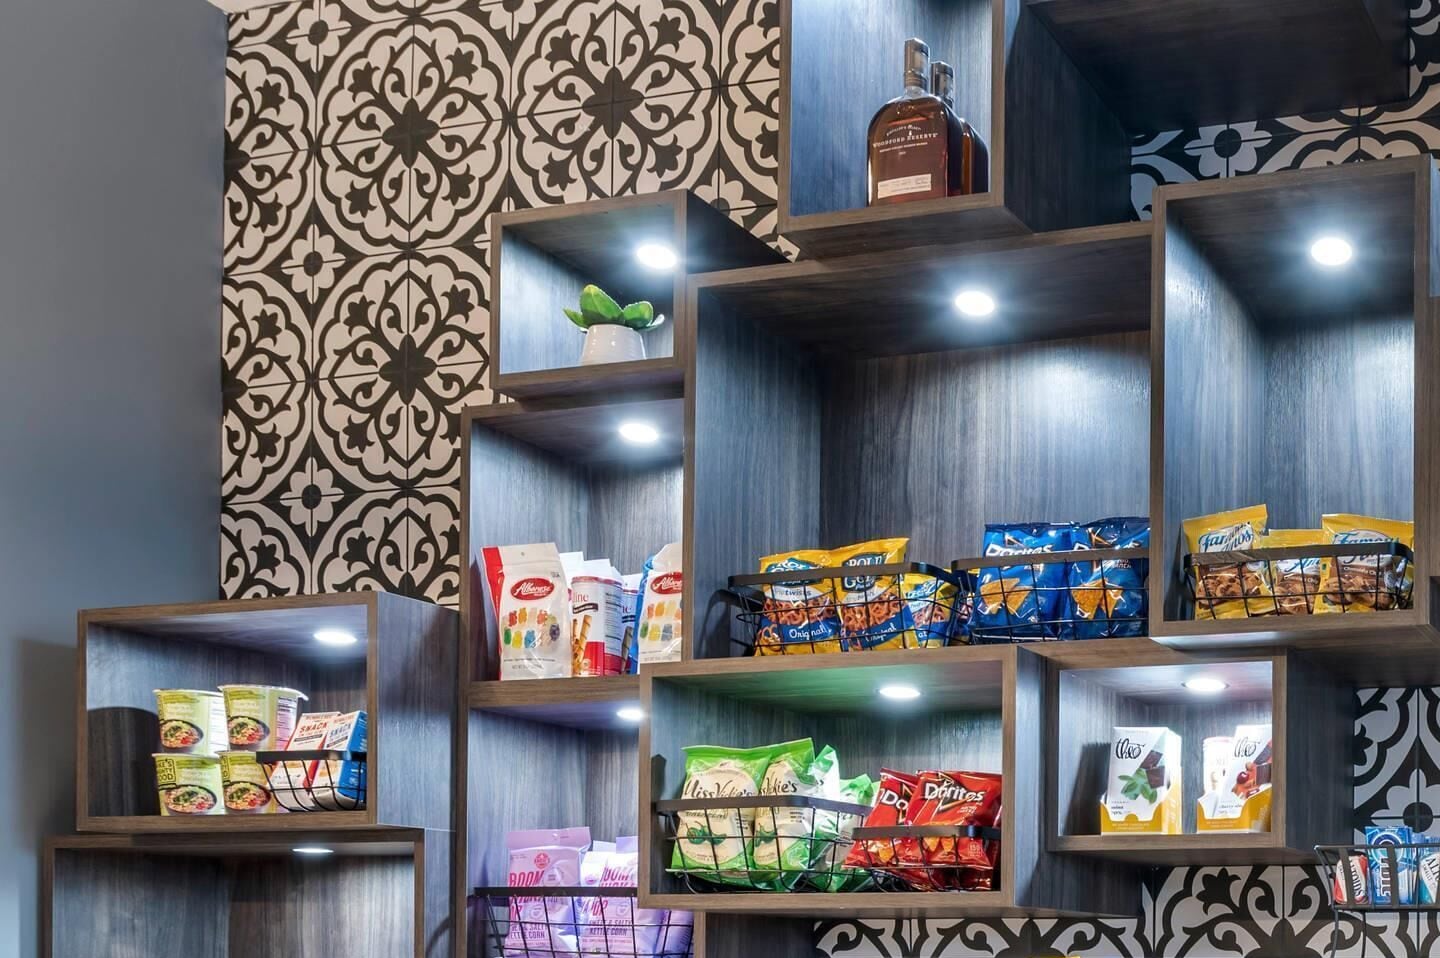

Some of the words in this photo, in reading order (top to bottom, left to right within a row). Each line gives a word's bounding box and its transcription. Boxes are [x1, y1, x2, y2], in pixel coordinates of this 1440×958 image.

[300, 722, 328, 734] SNACK
[924, 782, 986, 803] Doritos
[1350, 859, 1363, 897] LTOIDS
[611, 928, 628, 936] CORN
